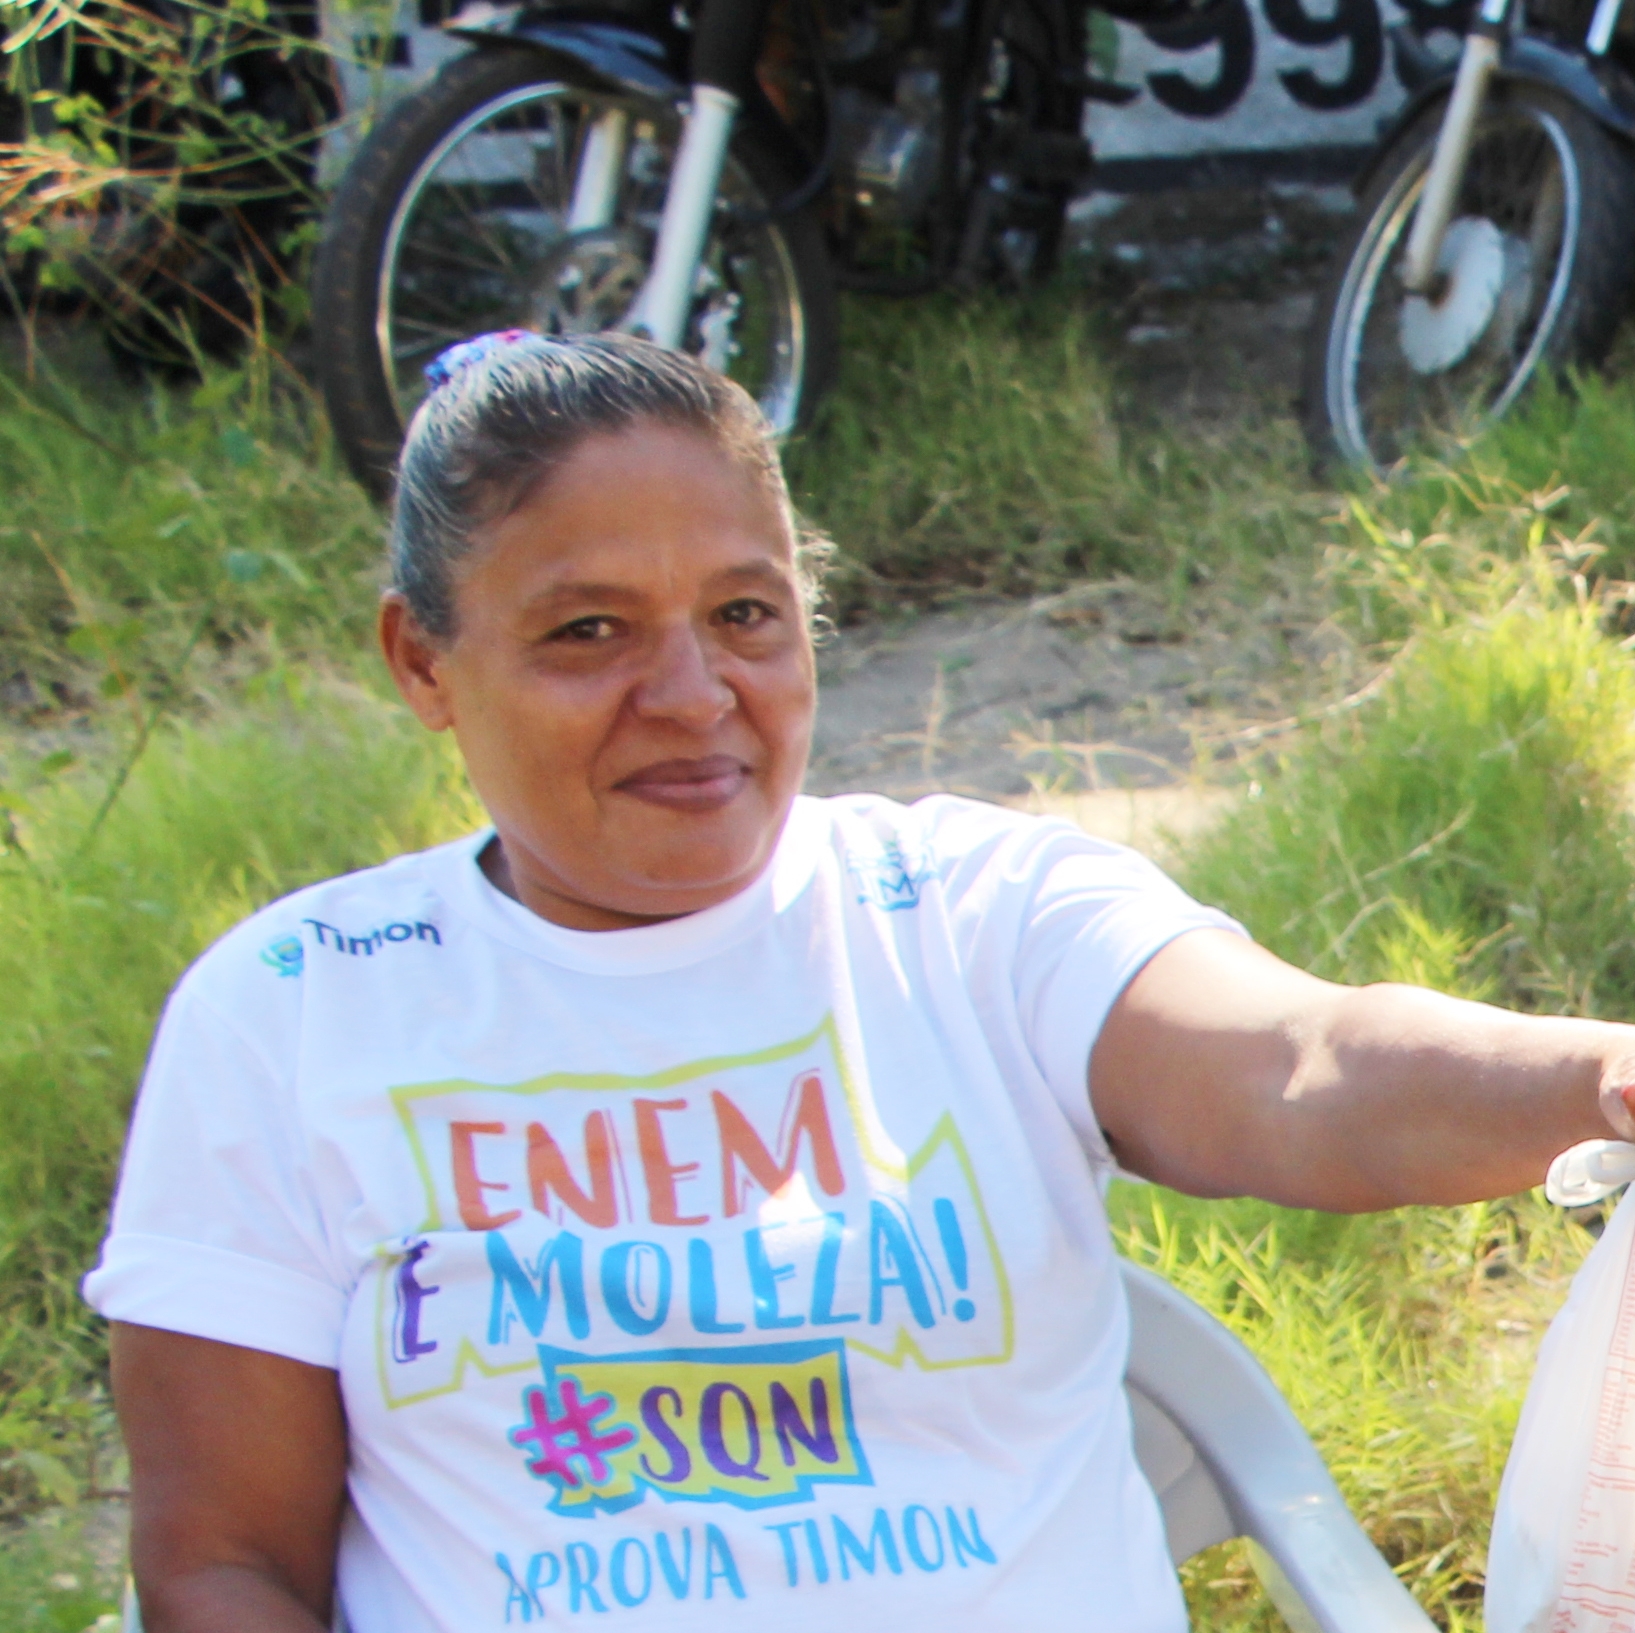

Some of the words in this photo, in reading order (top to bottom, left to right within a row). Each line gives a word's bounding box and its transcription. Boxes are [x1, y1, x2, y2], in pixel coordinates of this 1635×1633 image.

[448, 1066, 847, 1232] ENEM
[484, 1196, 978, 1347] MOLEZA!
[510, 1376, 838, 1487] #SQN
[495, 1523, 747, 1625] APROVA
[763, 1502, 999, 1588] TIMON
